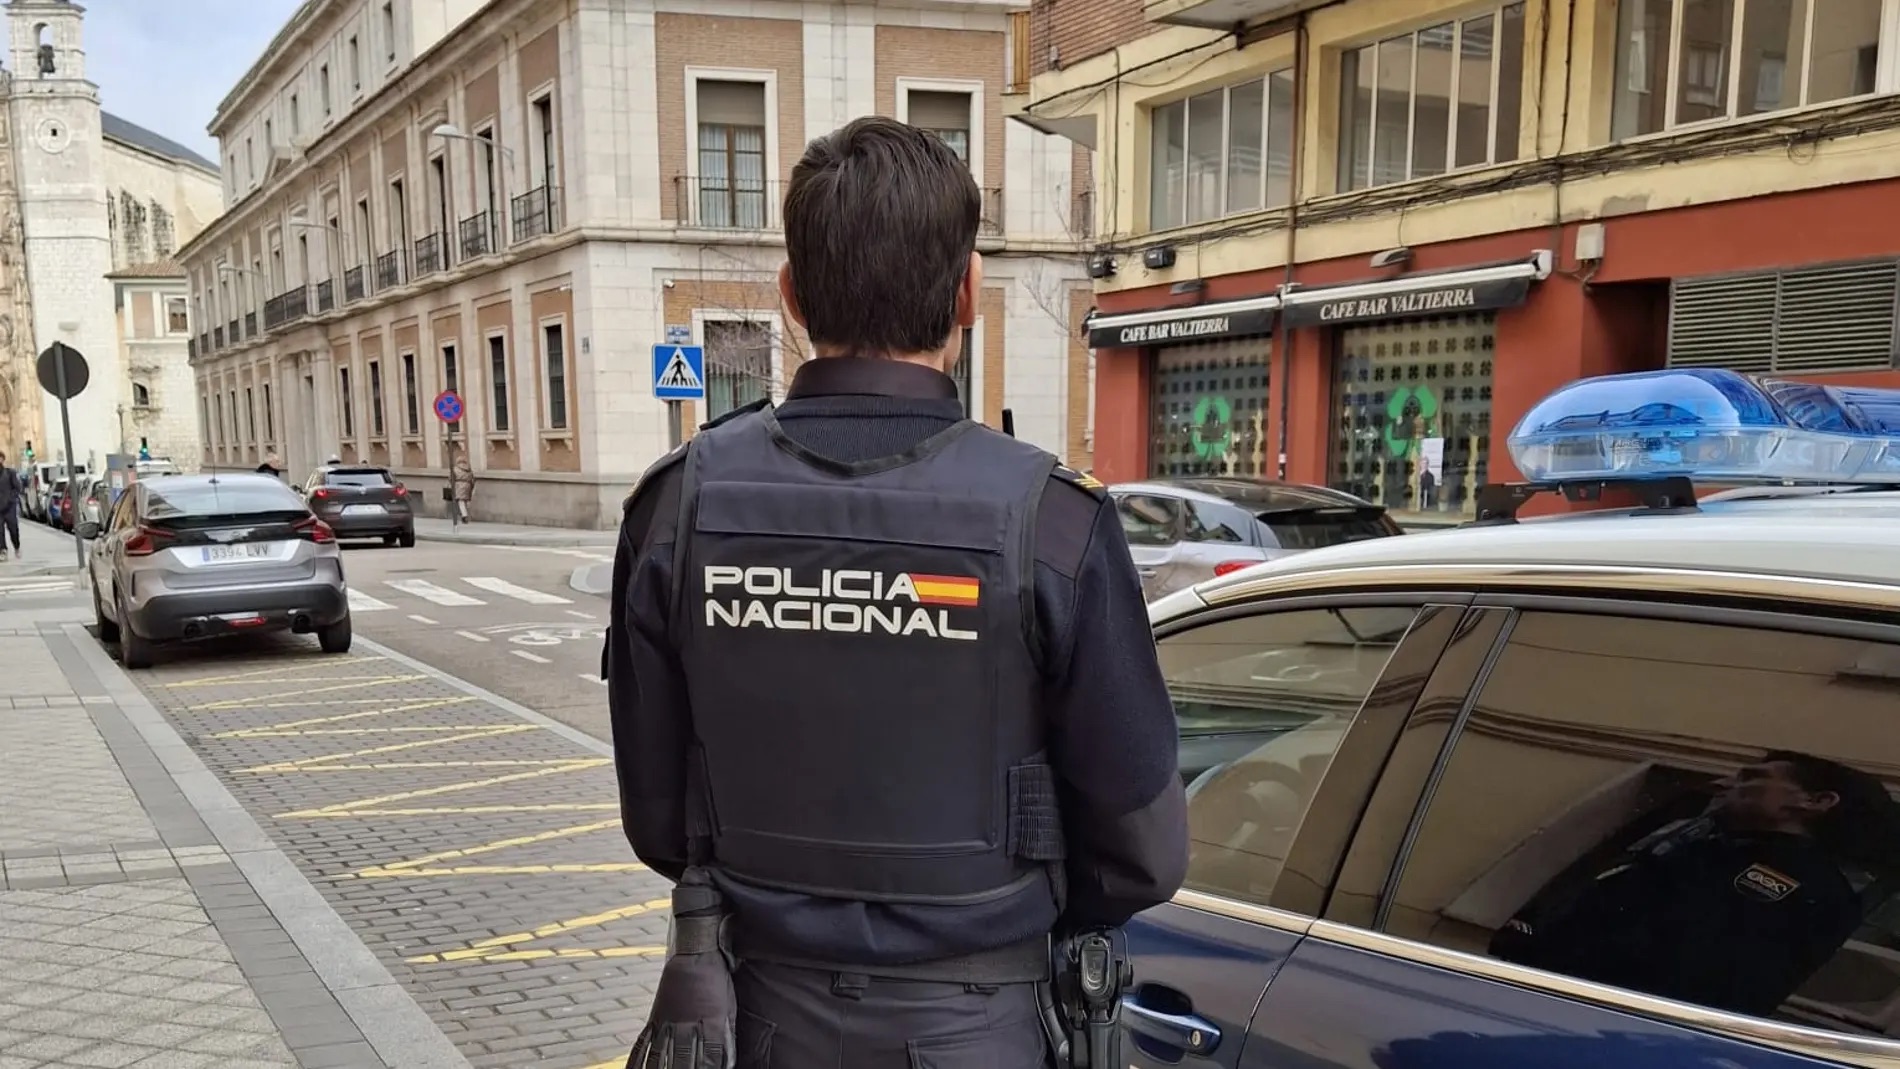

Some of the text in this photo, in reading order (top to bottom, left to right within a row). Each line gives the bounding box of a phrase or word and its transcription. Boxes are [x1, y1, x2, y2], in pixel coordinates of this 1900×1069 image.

[1320, 288, 1475, 320] CAFE BAR VALTIERRA
[1121, 317, 1229, 342] CAFE BAR VALTIERRA
[705, 565, 920, 602] POLICIA
[706, 599, 978, 640] NACIONAL
